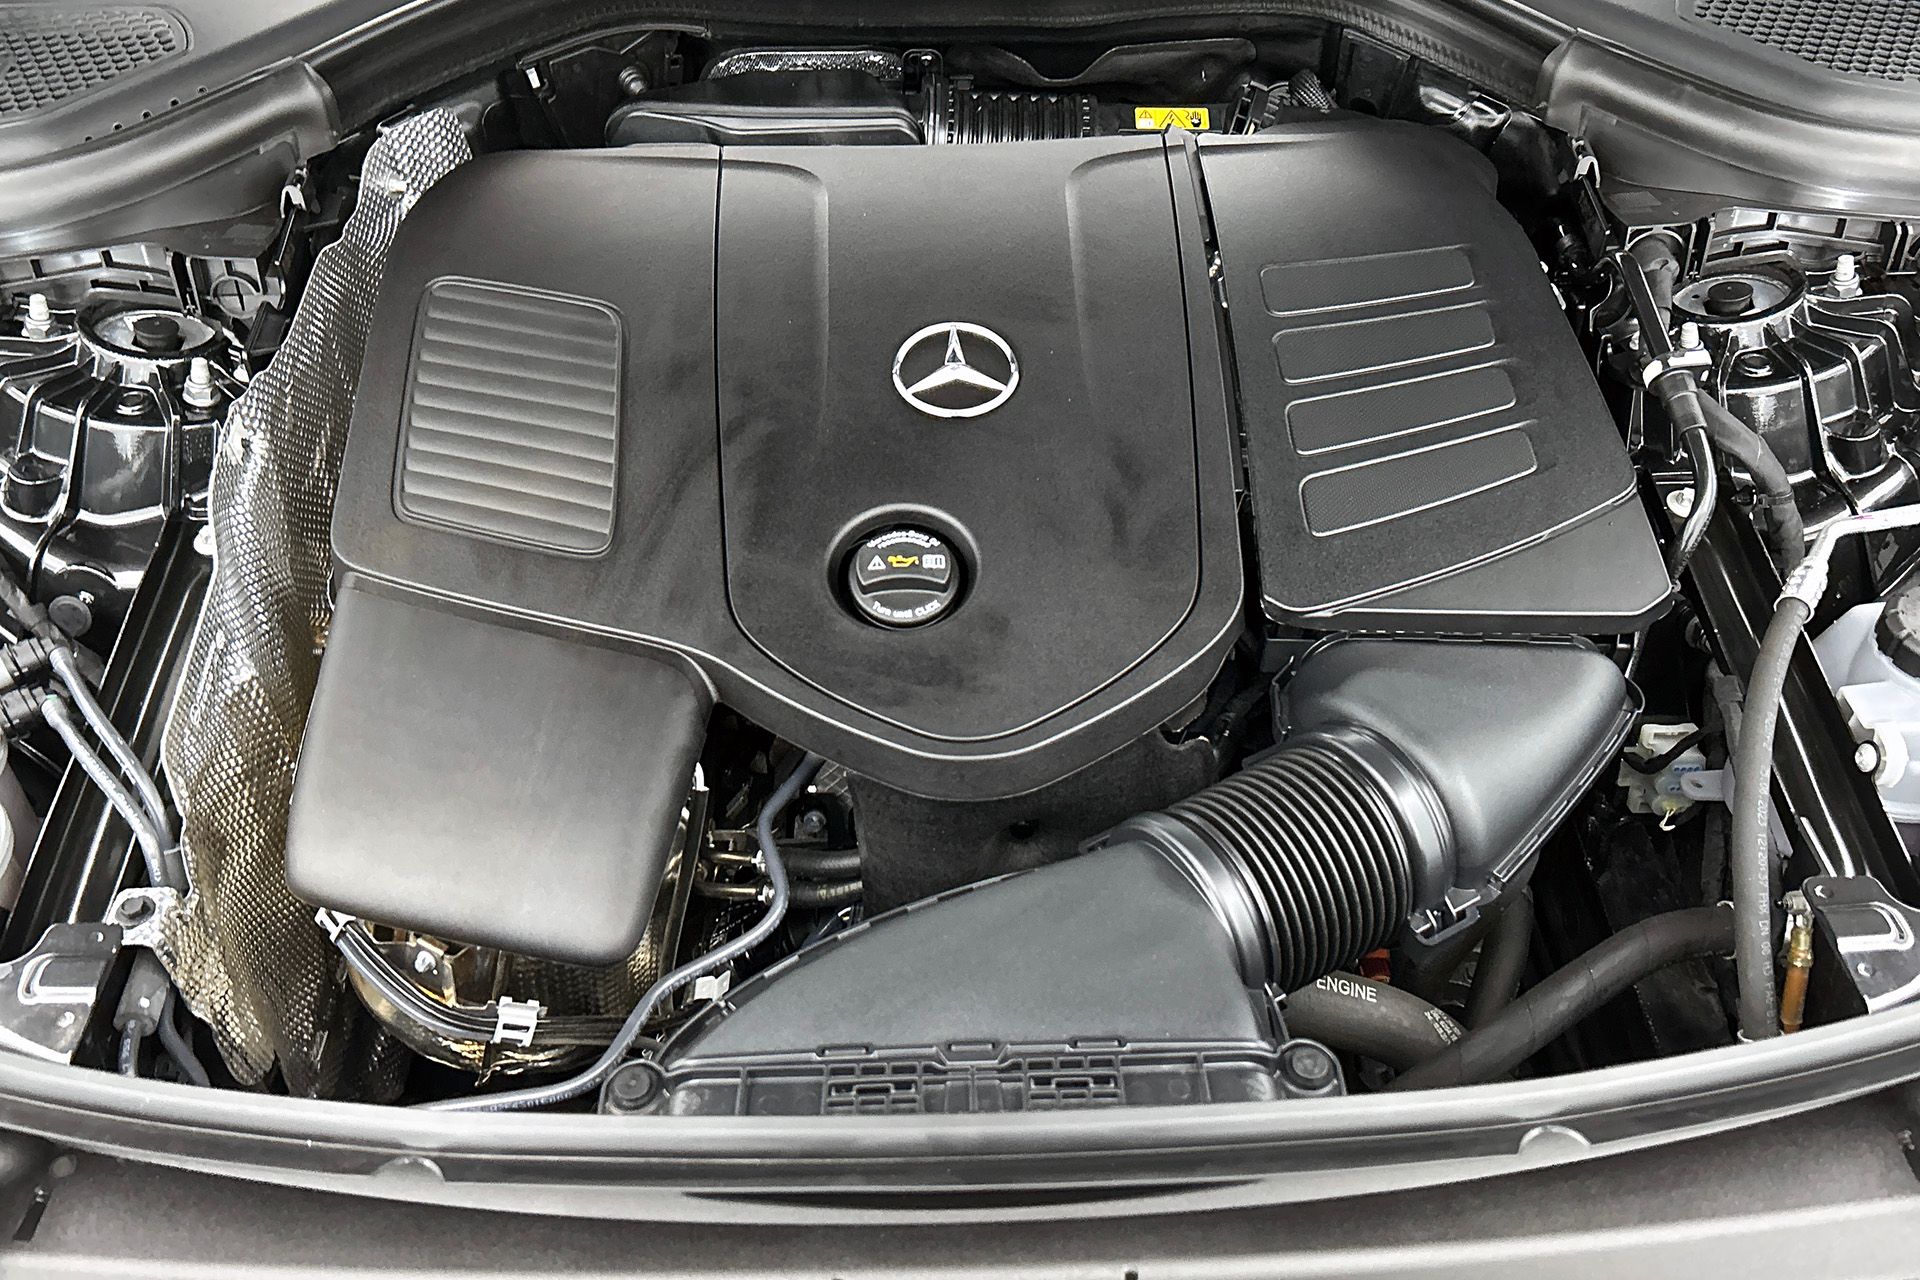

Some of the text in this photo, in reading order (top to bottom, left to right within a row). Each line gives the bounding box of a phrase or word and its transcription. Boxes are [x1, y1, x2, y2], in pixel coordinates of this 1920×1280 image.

[872, 600, 892, 616] Turn
[914, 599, 941, 616] CLICK
[1316, 975, 1377, 1003] ENGINE
